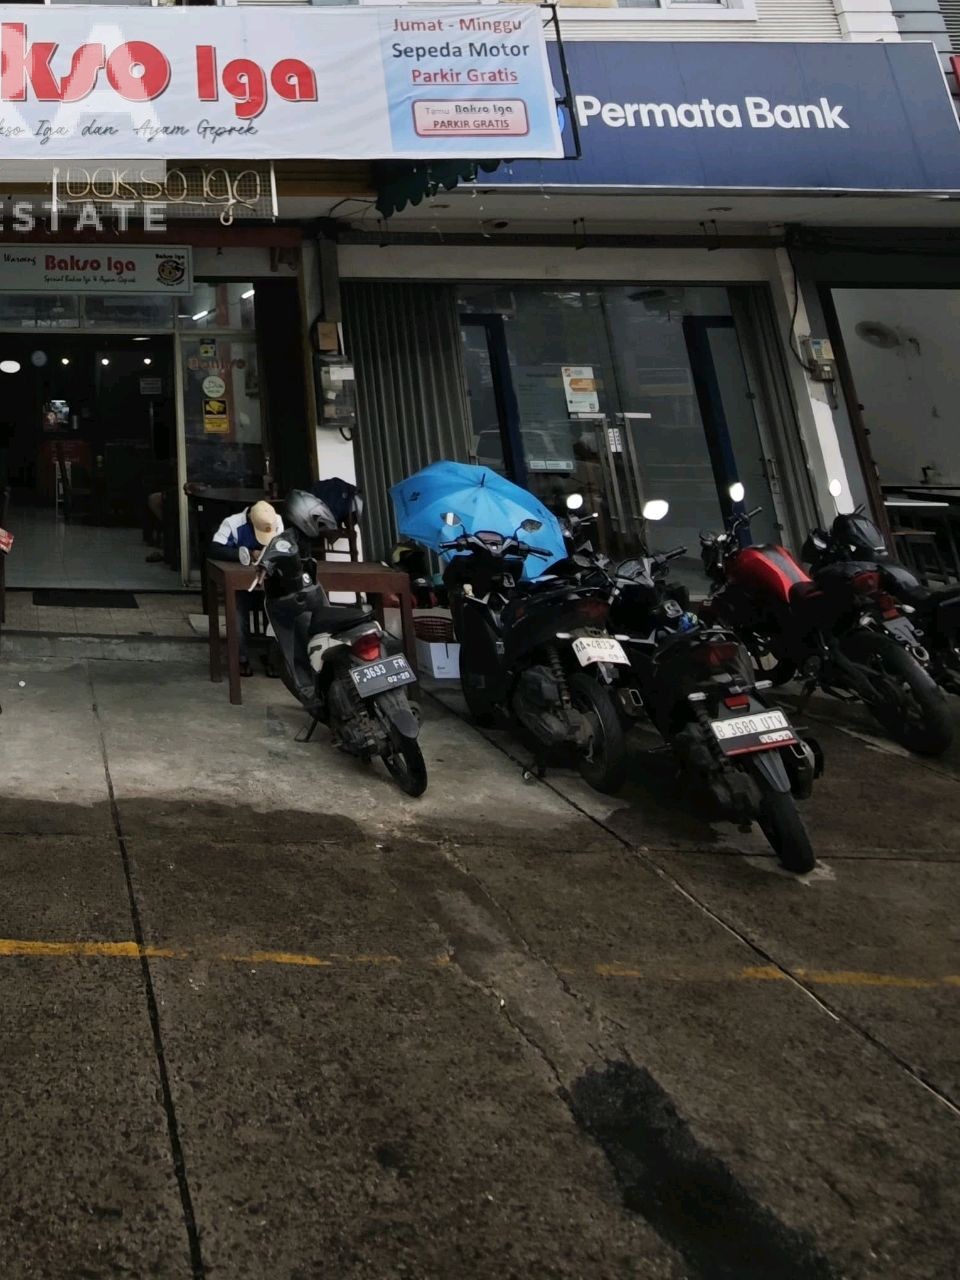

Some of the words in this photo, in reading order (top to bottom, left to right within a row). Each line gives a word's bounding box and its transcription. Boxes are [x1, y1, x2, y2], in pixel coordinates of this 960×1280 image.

[393, 18, 444, 32] Jumat
[459, 17, 522, 34] Minggu
[392, 42, 462, 61] Sepeda
[469, 42, 530, 57] Motor
[195, 44, 319, 120] Iga
[412, 68, 461, 83] Parkir
[467, 67, 518, 82] Gratis
[455, 104, 489, 113] Bakso
[493, 104, 513, 116] Iga
[575, 95, 743, 128] Permata
[745, 96, 850, 129] Bank
[32, 119, 69, 144] Iga
[81, 118, 119, 137] dan
[133, 119, 189, 144] Ayam
[197, 118, 258, 144] Geprek
[433, 120, 470, 129] PARKIR
[473, 120, 510, 128] GRATIS
[44, 255, 101, 271] Bakso
[107, 256, 136, 275] Iga
[716, 725, 725, 738] B
[728, 719, 758, 736] 3680
